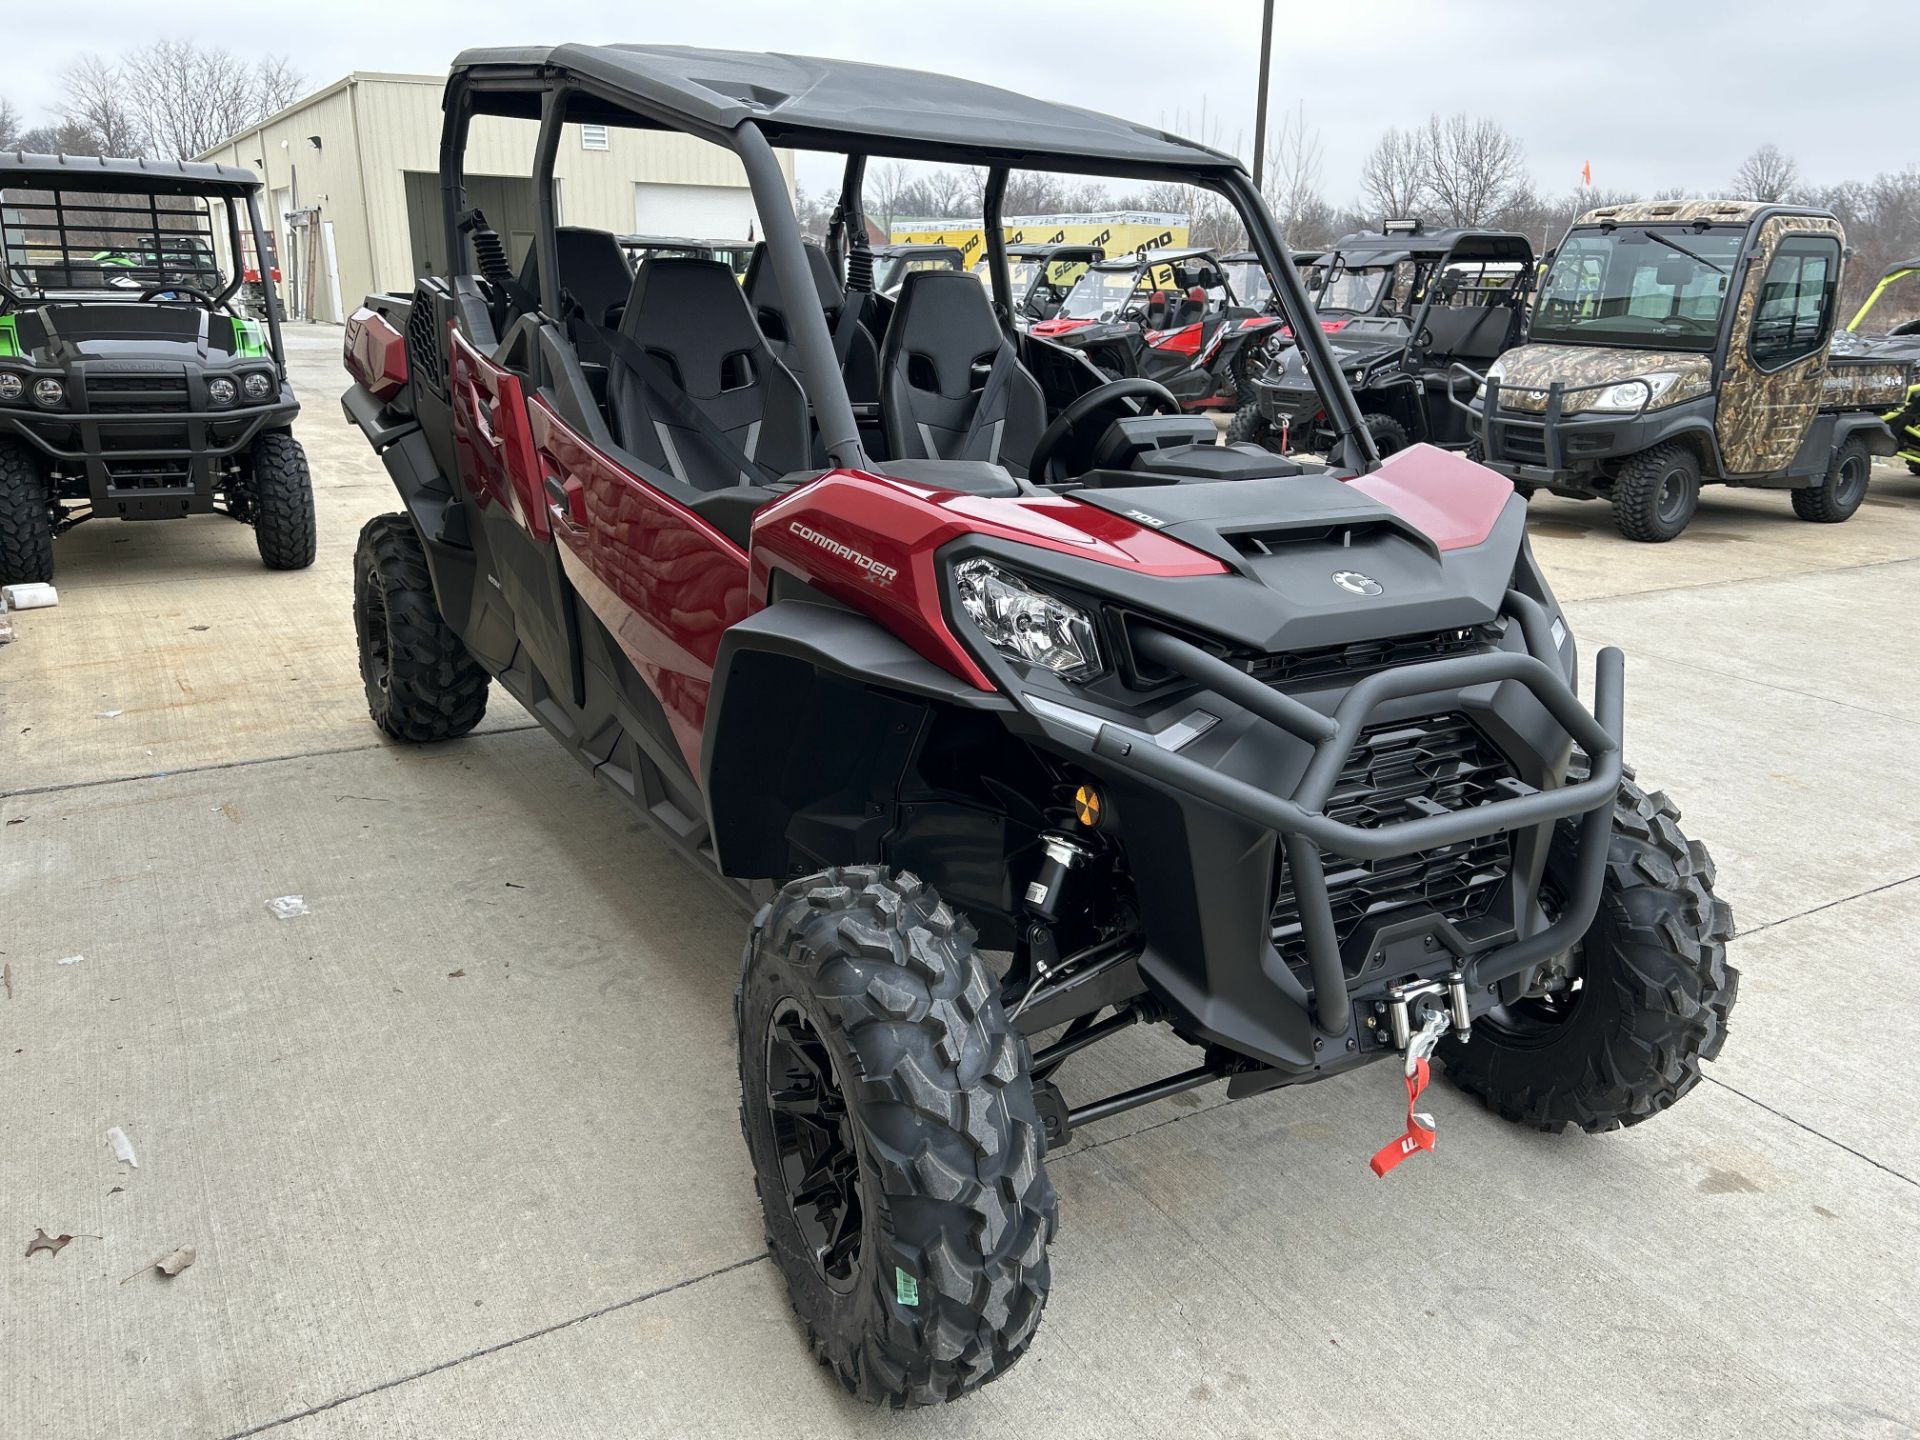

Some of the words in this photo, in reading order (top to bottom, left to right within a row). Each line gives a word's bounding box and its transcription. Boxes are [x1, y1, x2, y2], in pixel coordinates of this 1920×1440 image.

[1123, 509, 1165, 526] 700
[788, 521, 898, 581] COMMANDER
[863, 571, 892, 588] XT
